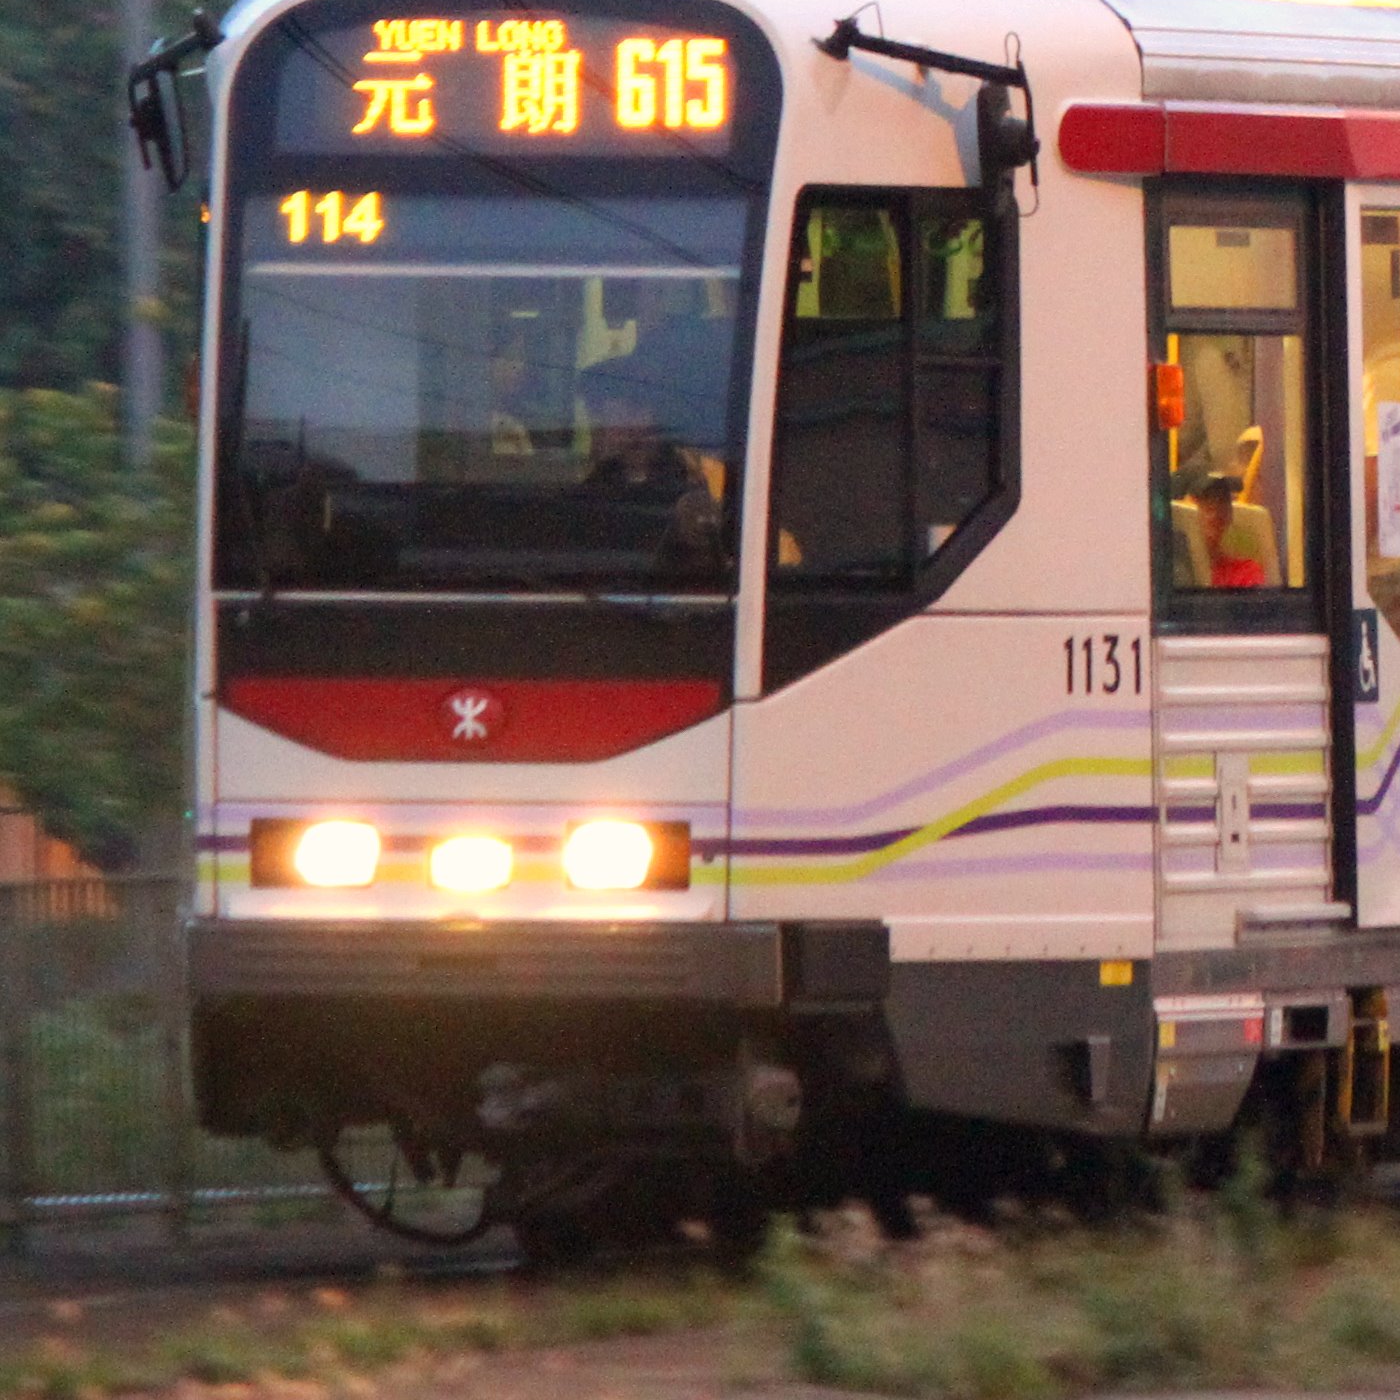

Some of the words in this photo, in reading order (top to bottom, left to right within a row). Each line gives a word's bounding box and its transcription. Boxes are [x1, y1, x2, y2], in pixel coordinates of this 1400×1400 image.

[373, 20, 462, 52] YUEN
[474, 20, 567, 52] LONG
[352, 49, 580, 134] 元朗
[614, 38, 727, 130] 615
[280, 191, 384, 244] 114
[1063, 634, 1142, 695] 1131
